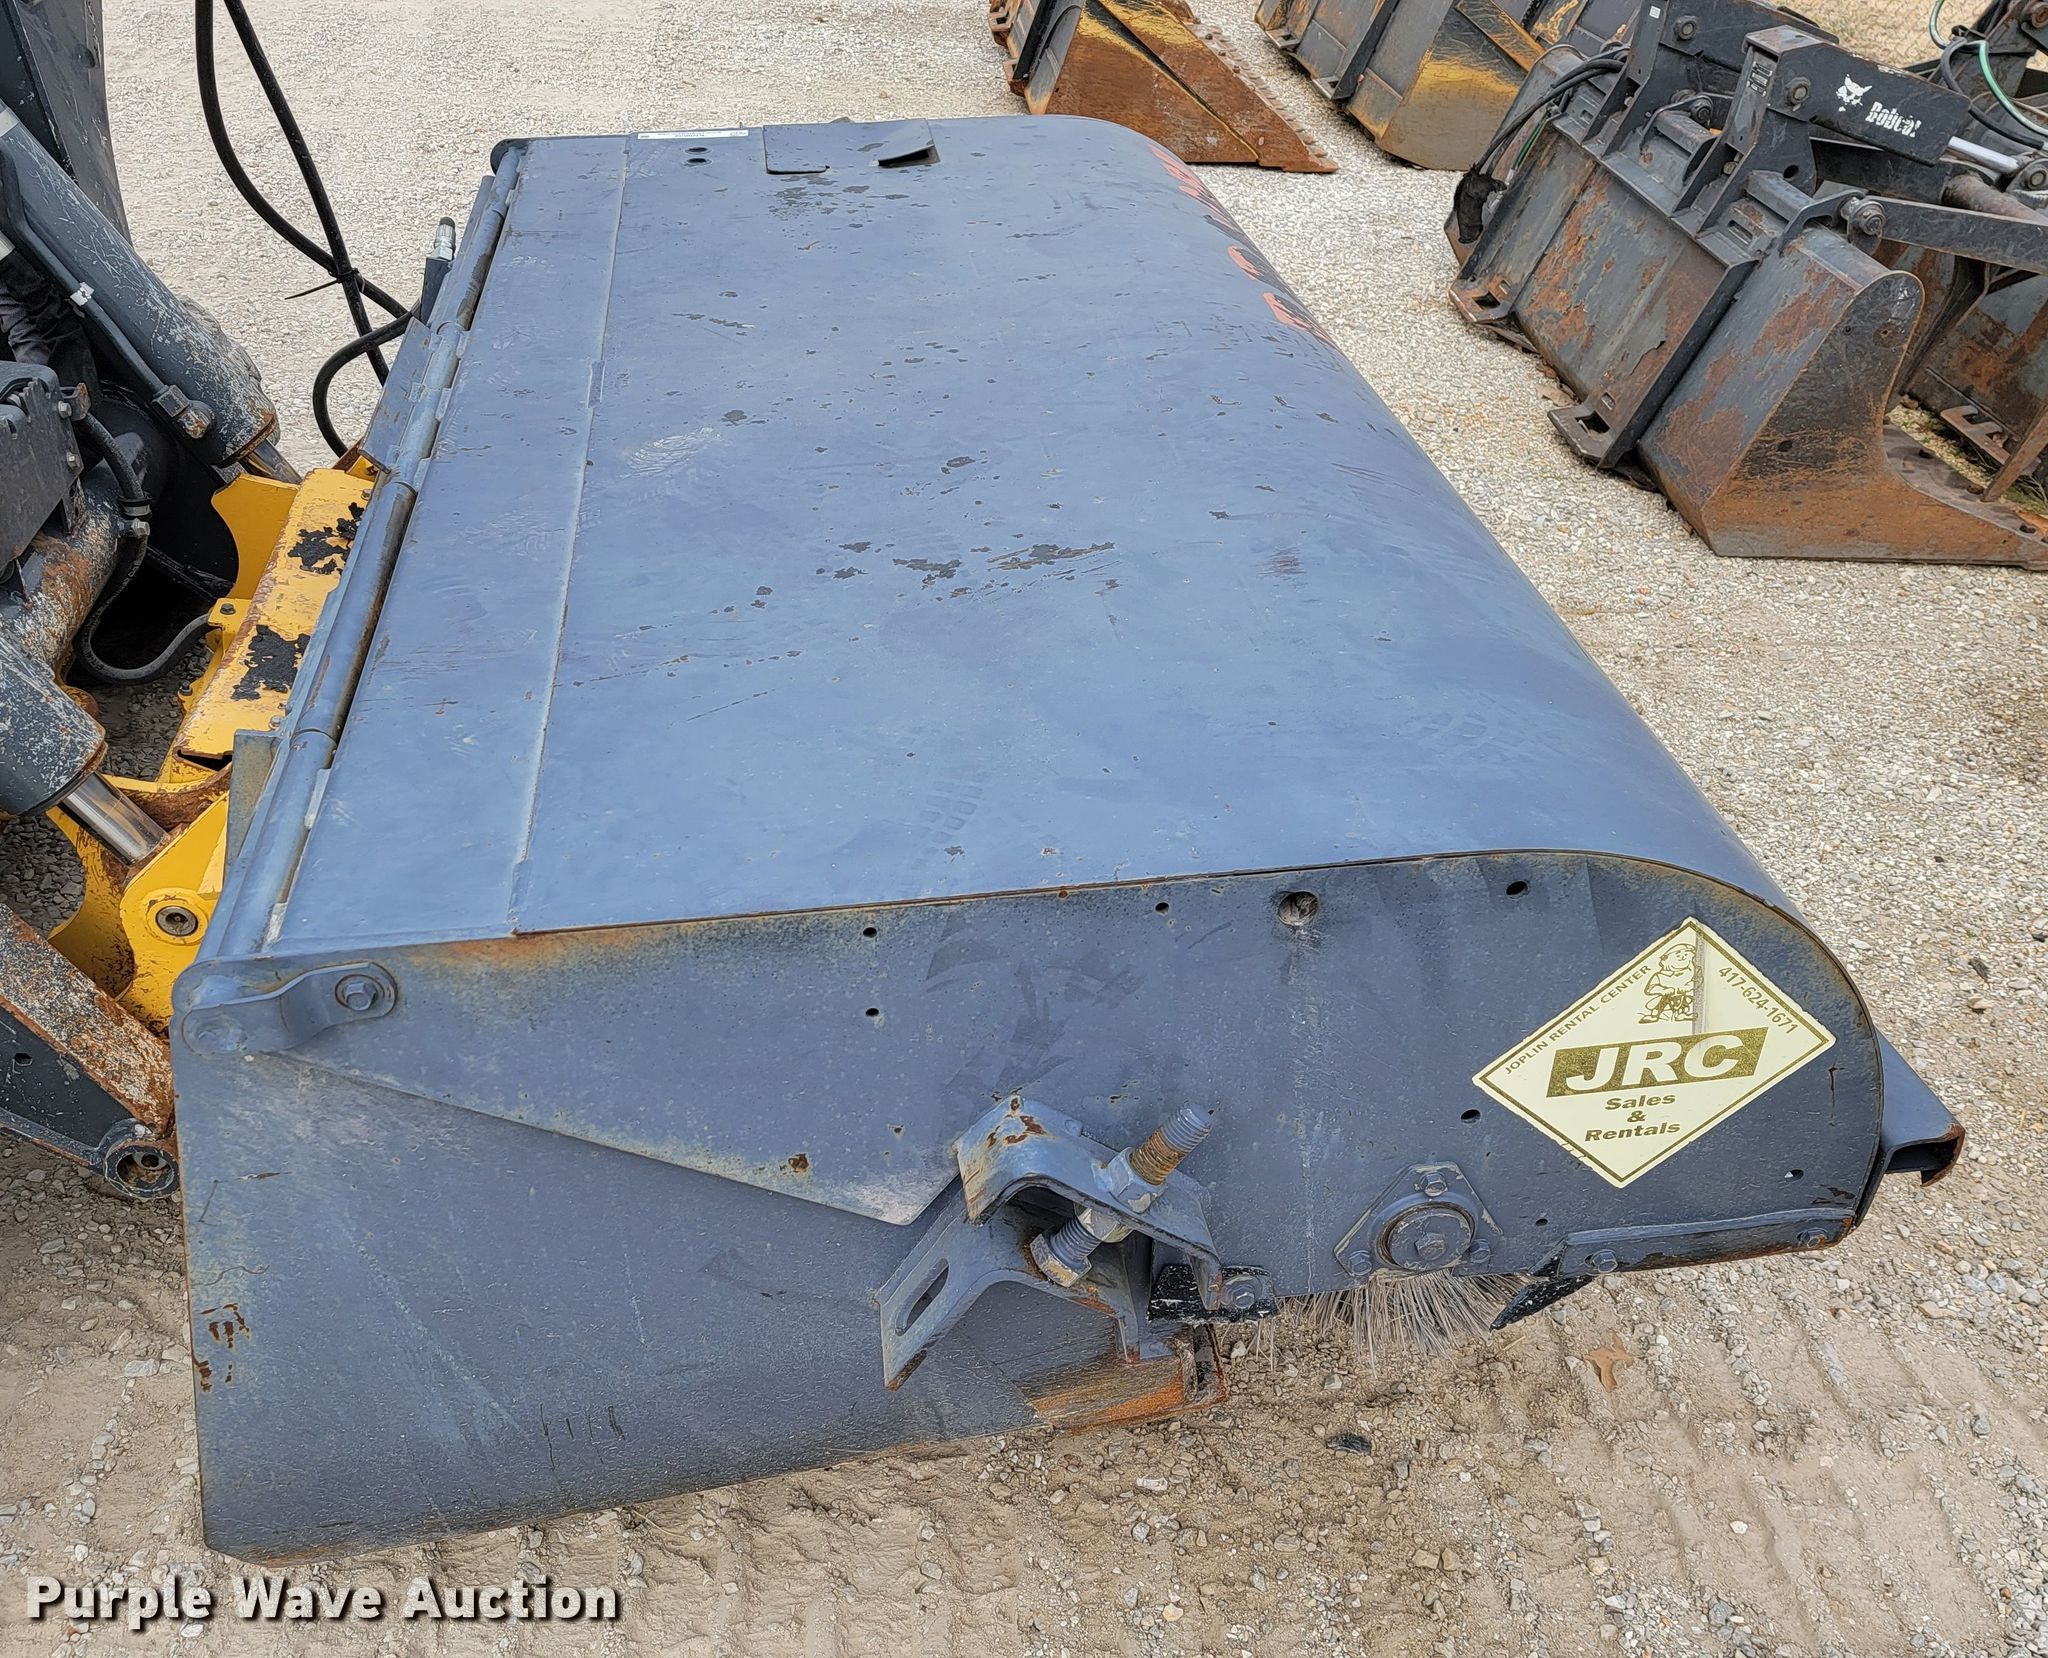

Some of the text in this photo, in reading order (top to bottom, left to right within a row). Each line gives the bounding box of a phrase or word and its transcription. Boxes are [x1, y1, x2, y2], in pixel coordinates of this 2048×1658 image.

[1505, 964, 1652, 1075] JOPLIN RENTAL CENTER
[1717, 966, 1799, 1036] 417-624-1671
[1565, 1033, 1744, 1091] JRC
[1605, 1092, 1677, 1111] Sales
[1626, 1110, 1647, 1124] &
[1584, 1121, 1682, 1143] Rentals
